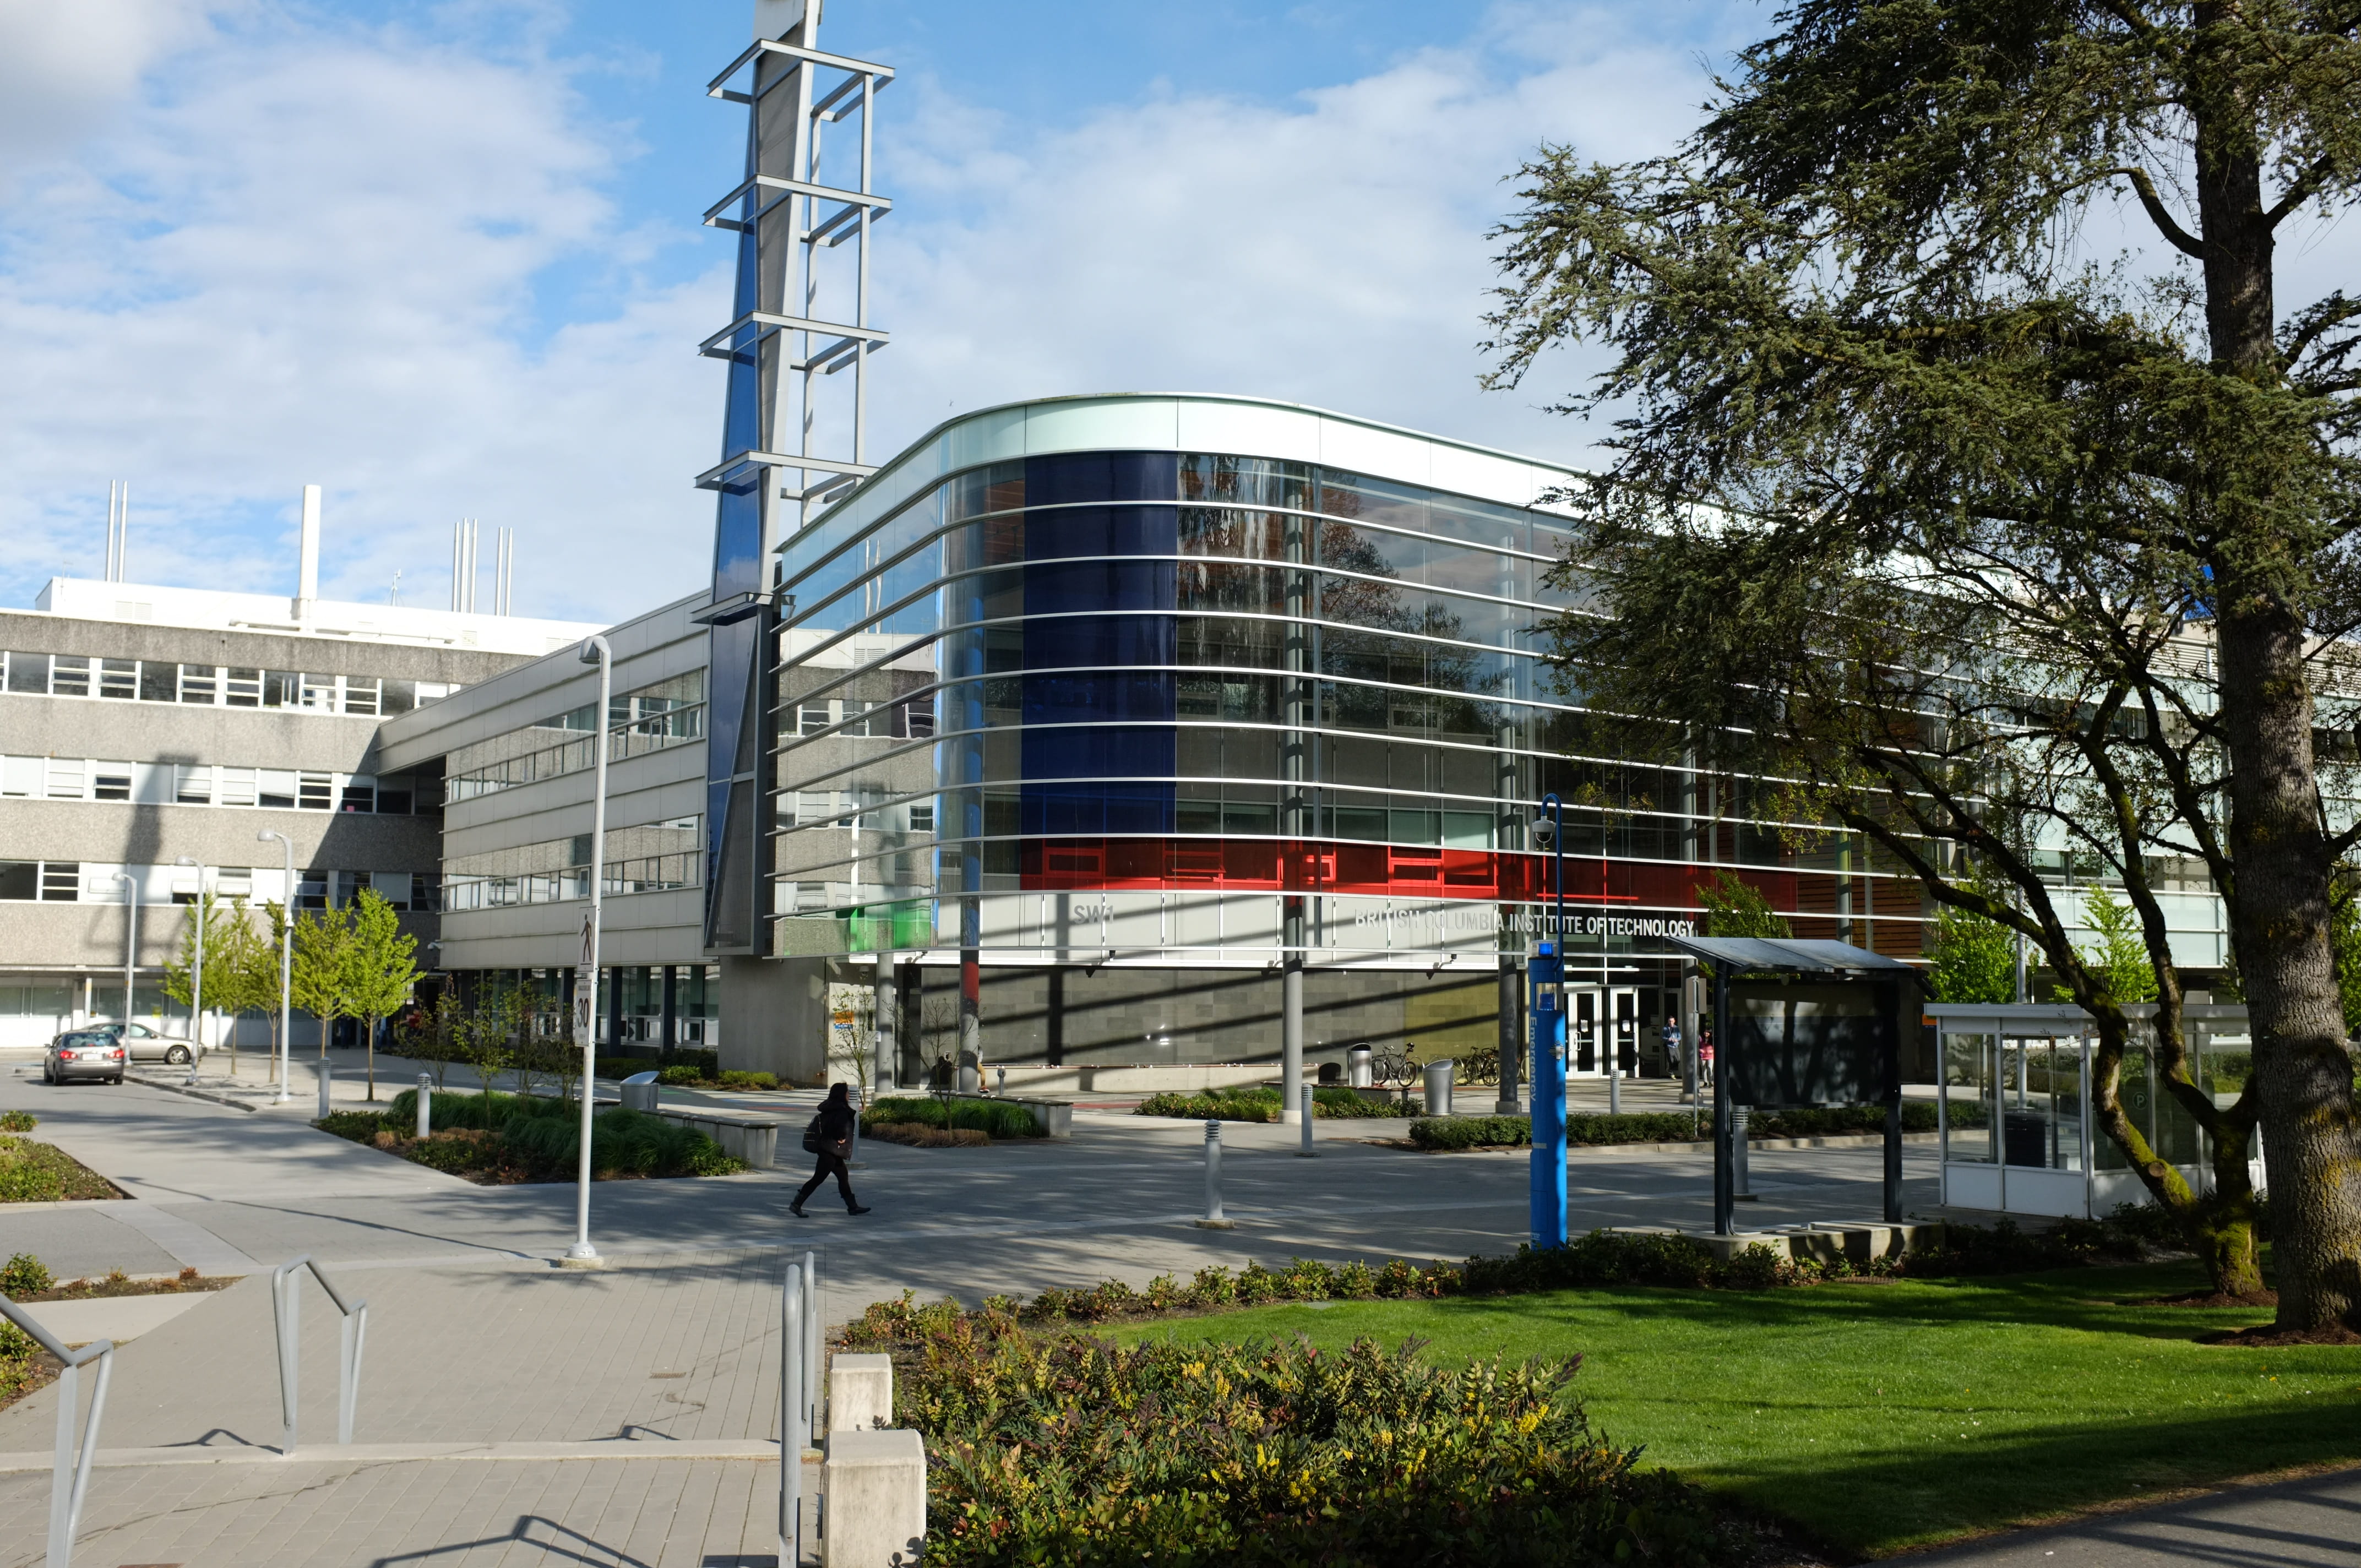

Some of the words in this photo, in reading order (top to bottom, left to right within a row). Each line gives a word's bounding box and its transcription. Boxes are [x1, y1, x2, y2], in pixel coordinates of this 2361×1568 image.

[1074, 905, 1113, 924] SW1
[1354, 908, 1419, 928] BRITISH
[1425, 910, 1505, 931] COLUMBIA
[1586, 916, 1605, 934] OF
[1608, 917, 1694, 938] TECHNOLOGY
[577, 997, 589, 1028] 30
